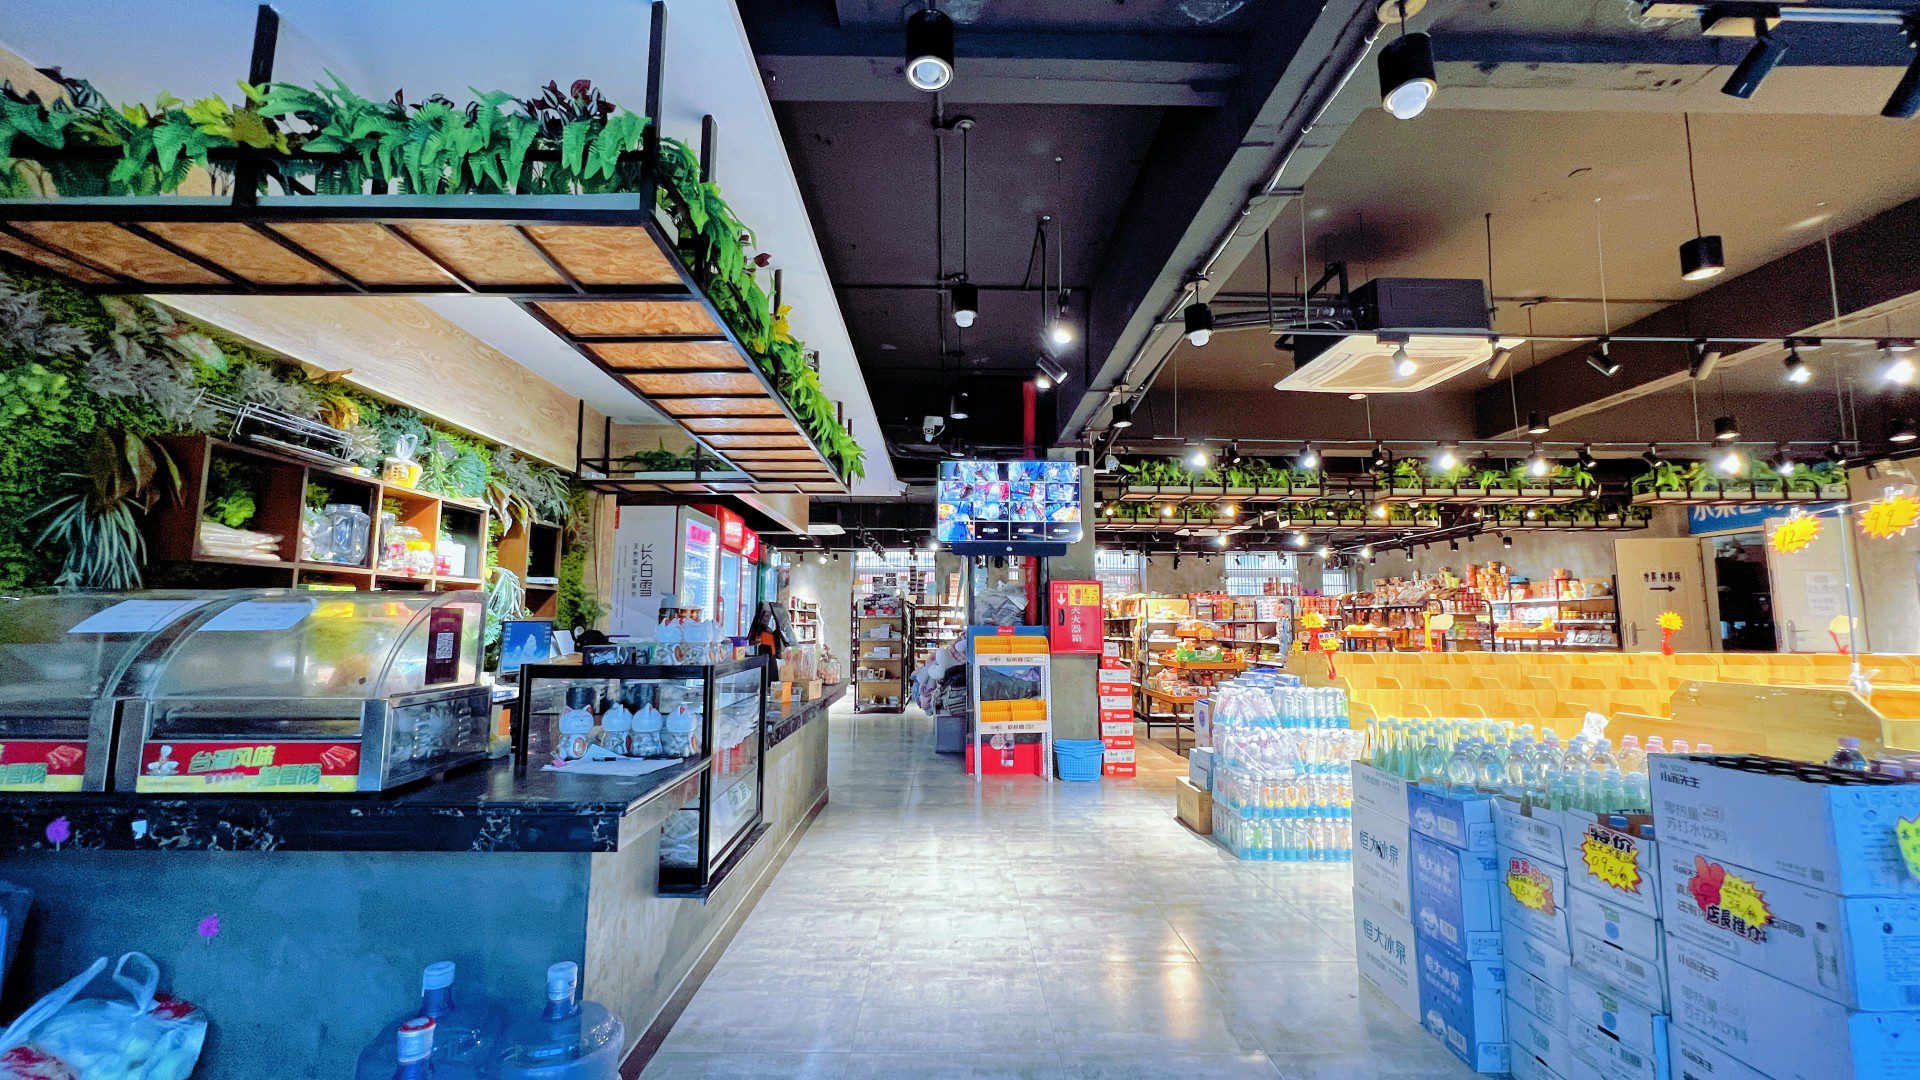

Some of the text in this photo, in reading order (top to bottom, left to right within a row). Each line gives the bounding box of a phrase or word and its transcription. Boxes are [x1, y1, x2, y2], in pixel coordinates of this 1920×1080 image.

[640, 543, 653, 597] 长白雪
[1359, 829, 1400, 868] 恒大冰泉
[1590, 826, 1632, 854] 特价
[1362, 917, 1407, 966] 恒大冰泉
[1424, 953, 1461, 991] 恒大冰泉
